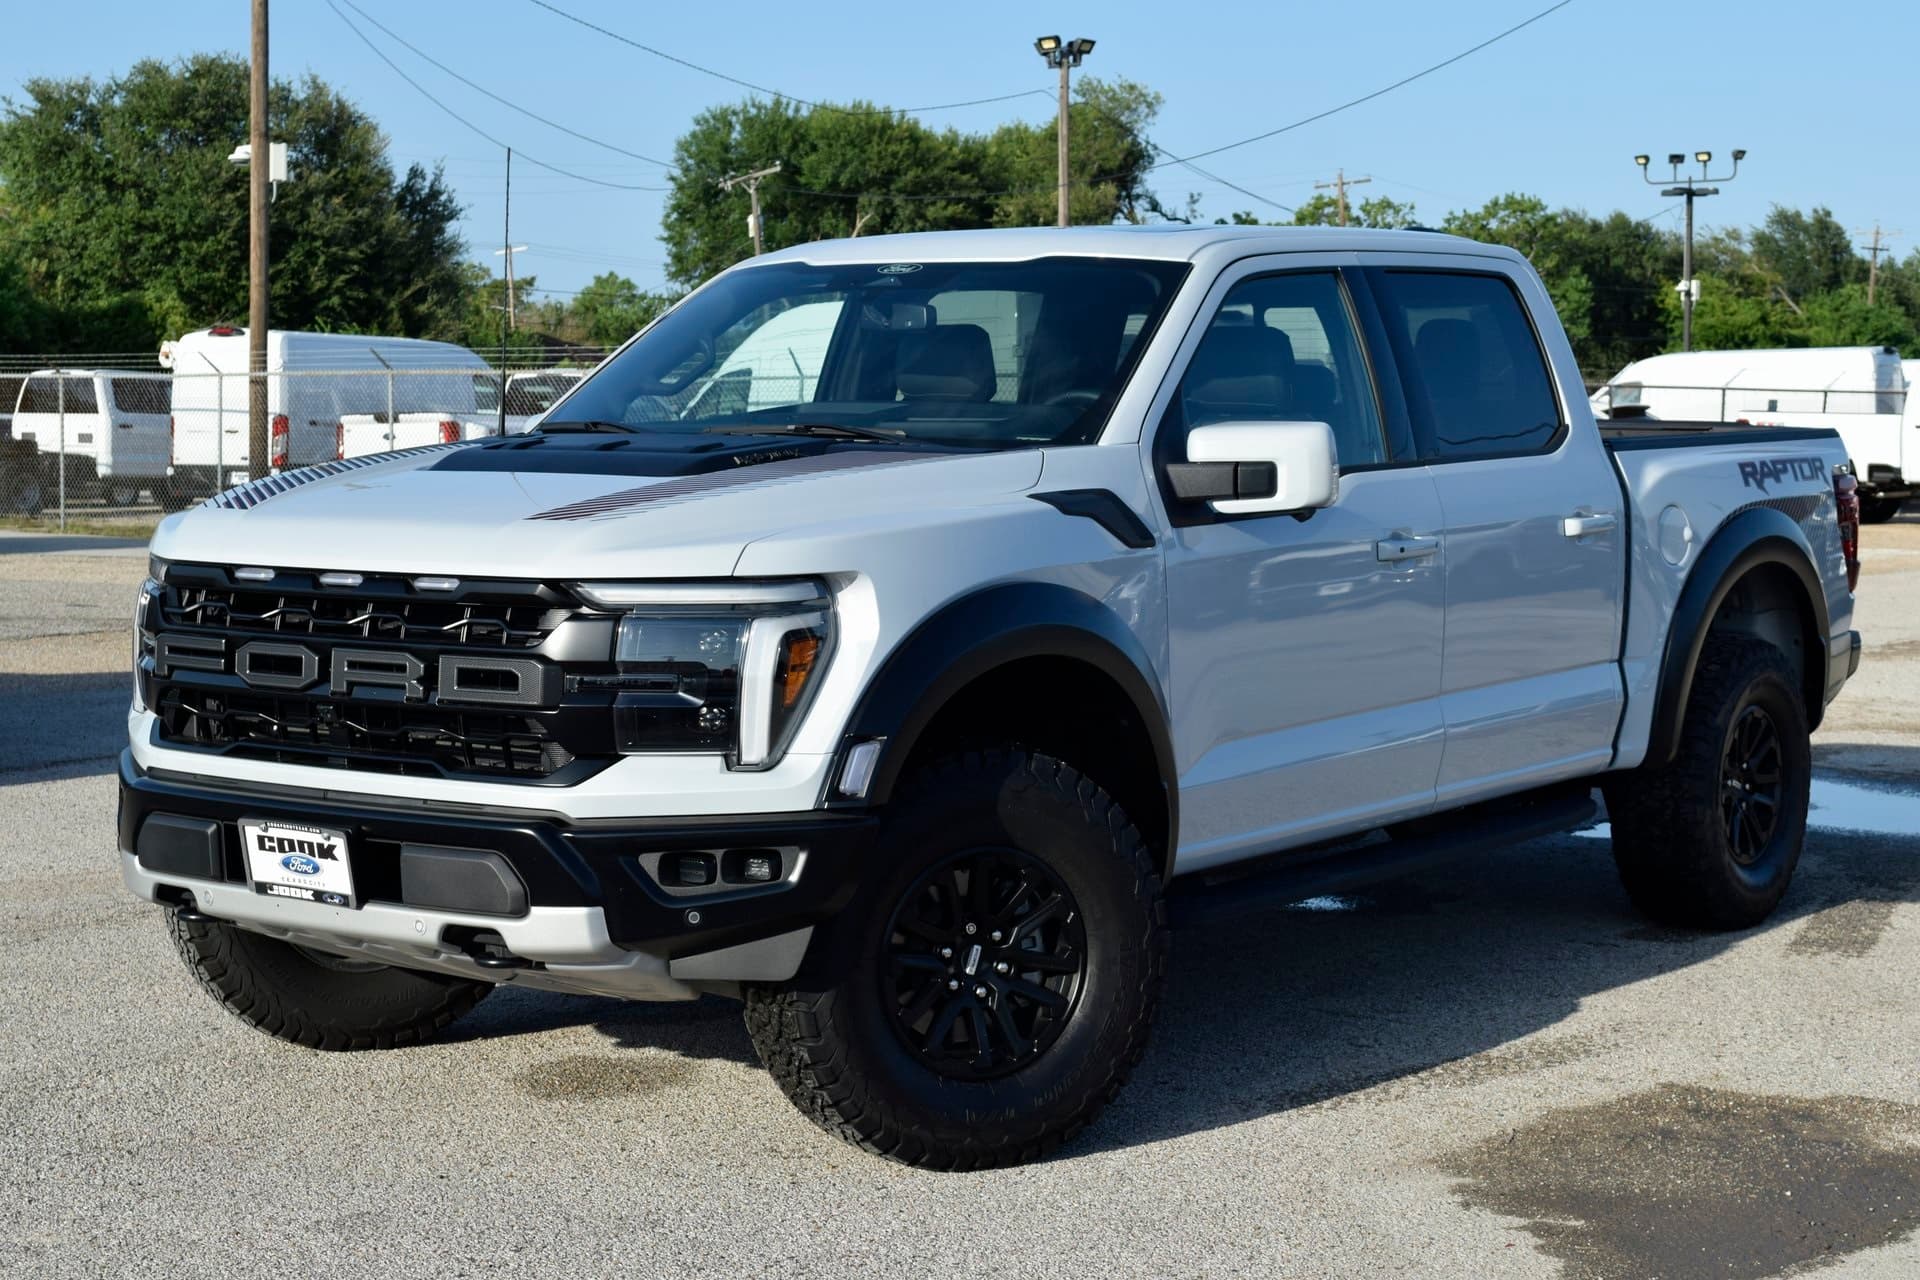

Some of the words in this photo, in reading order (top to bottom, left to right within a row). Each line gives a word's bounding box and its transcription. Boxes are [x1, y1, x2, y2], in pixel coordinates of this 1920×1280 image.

[1737, 456, 1833, 496] RAPTOR
[155, 632, 544, 706] FORD
[256, 834, 340, 861] COOK
[289, 857, 315, 874] Ford
